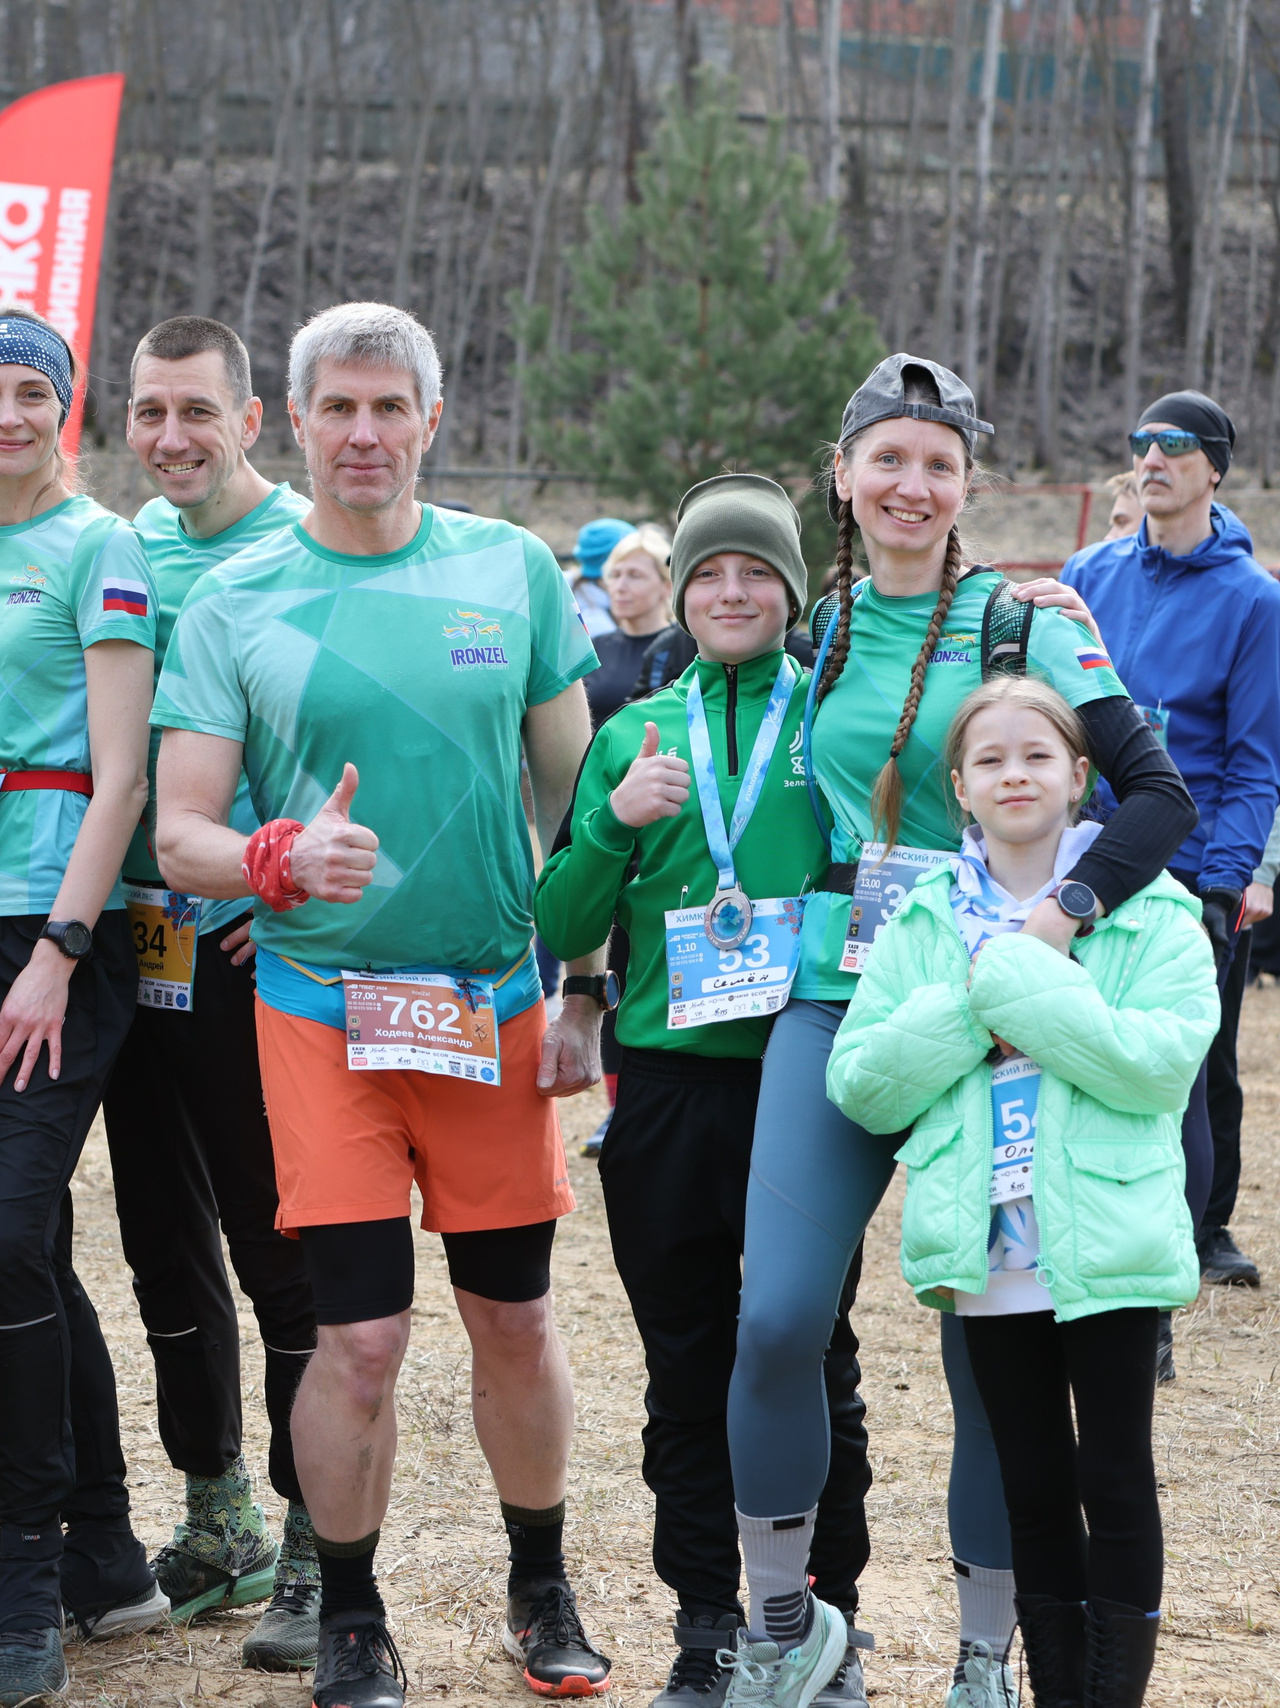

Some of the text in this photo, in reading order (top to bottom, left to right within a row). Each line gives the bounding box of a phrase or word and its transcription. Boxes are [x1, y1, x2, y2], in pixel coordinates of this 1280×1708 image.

[6, 590, 41, 606] IRONZEL
[450, 647, 509, 666] IRONZEL
[926, 650, 972, 664] RONZEL
[860, 877, 881, 889] 13,00
[880, 883, 907, 921] 3
[675, 912, 706, 923] ХИМК
[676, 942, 697, 954] 1,10
[718, 933, 770, 972] 53
[139, 959, 165, 971] Андрей
[421, 976, 440, 984] ЛЕС
[351, 991, 377, 1001] 27,00
[382, 995, 462, 1034] 762
[374, 1028, 473, 1048] Ходеев Александр
[1000, 1098, 1038, 1141] 5
